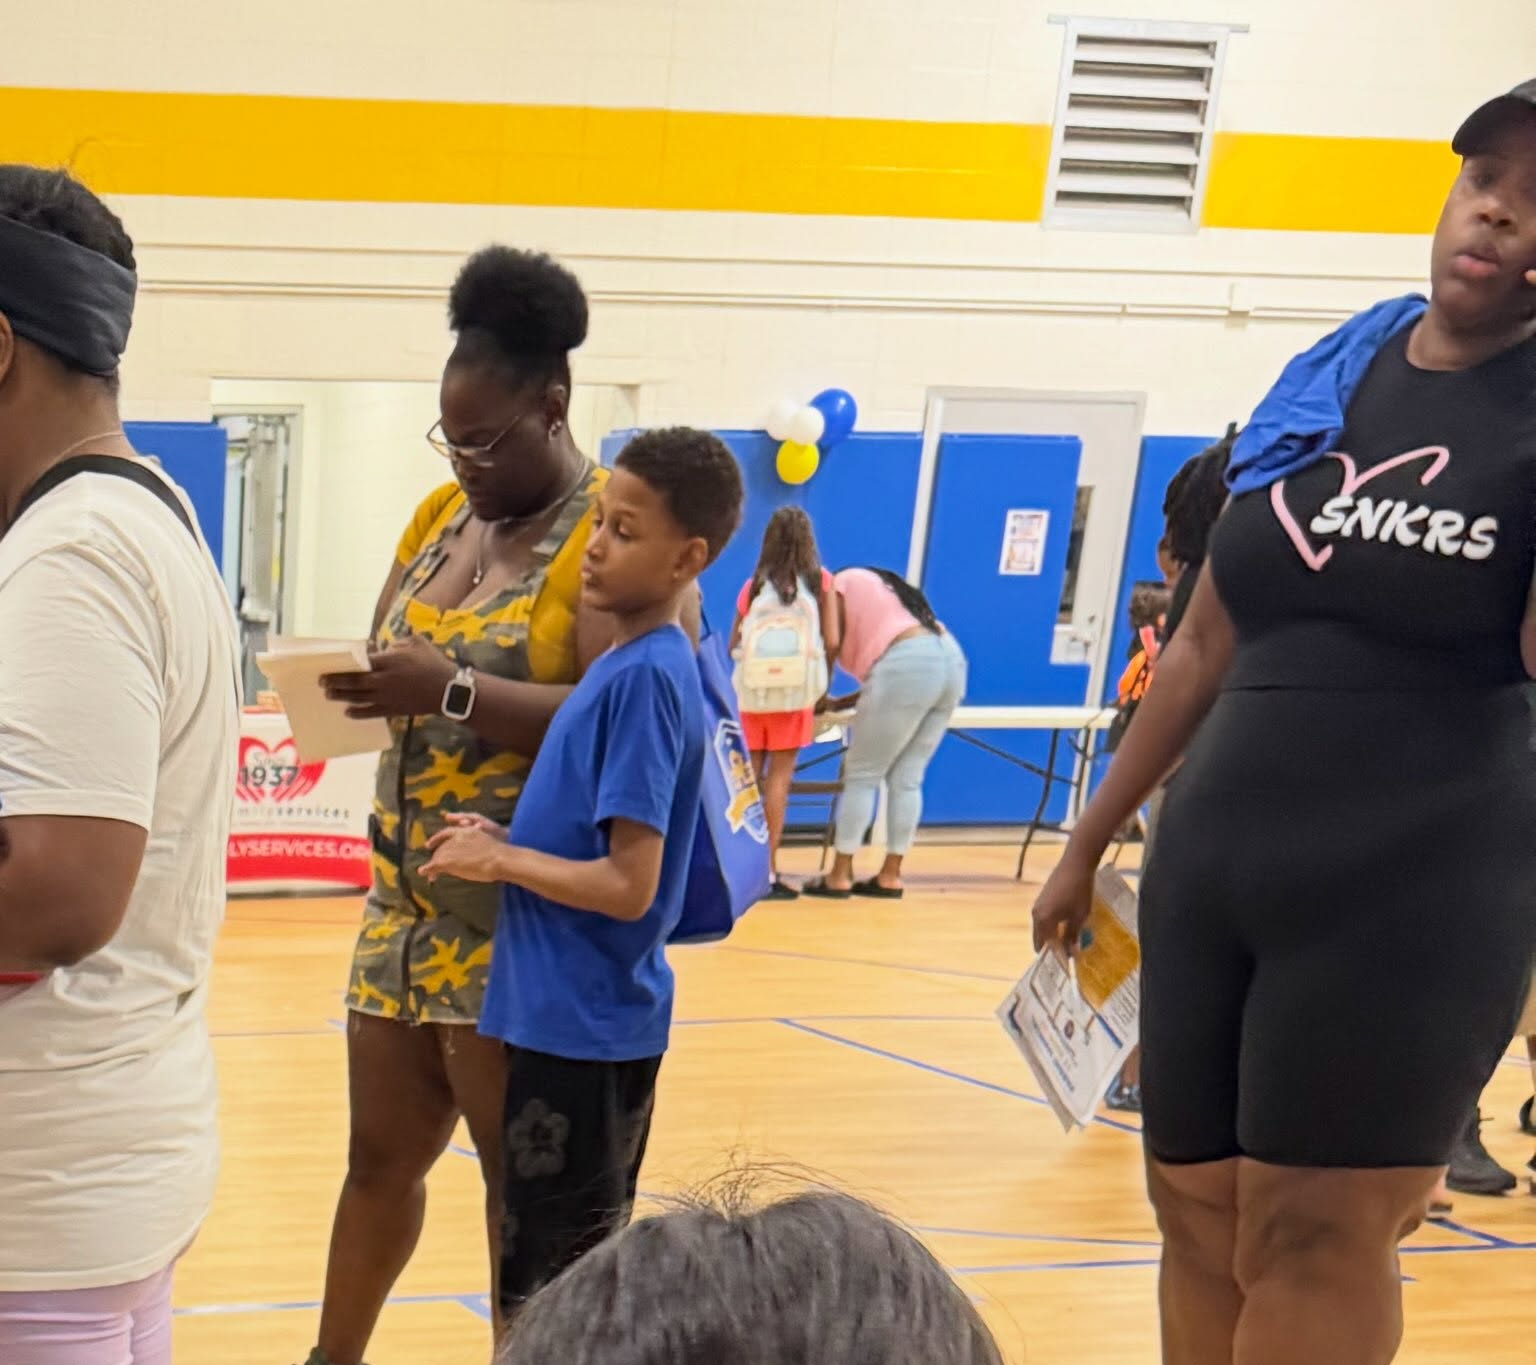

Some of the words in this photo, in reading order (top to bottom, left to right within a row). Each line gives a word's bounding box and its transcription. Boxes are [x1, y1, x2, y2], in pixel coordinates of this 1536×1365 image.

[1310, 495, 1498, 560] SNKRS
[144, 711, 198, 743] 115
[241, 766, 298, 787] 1937
